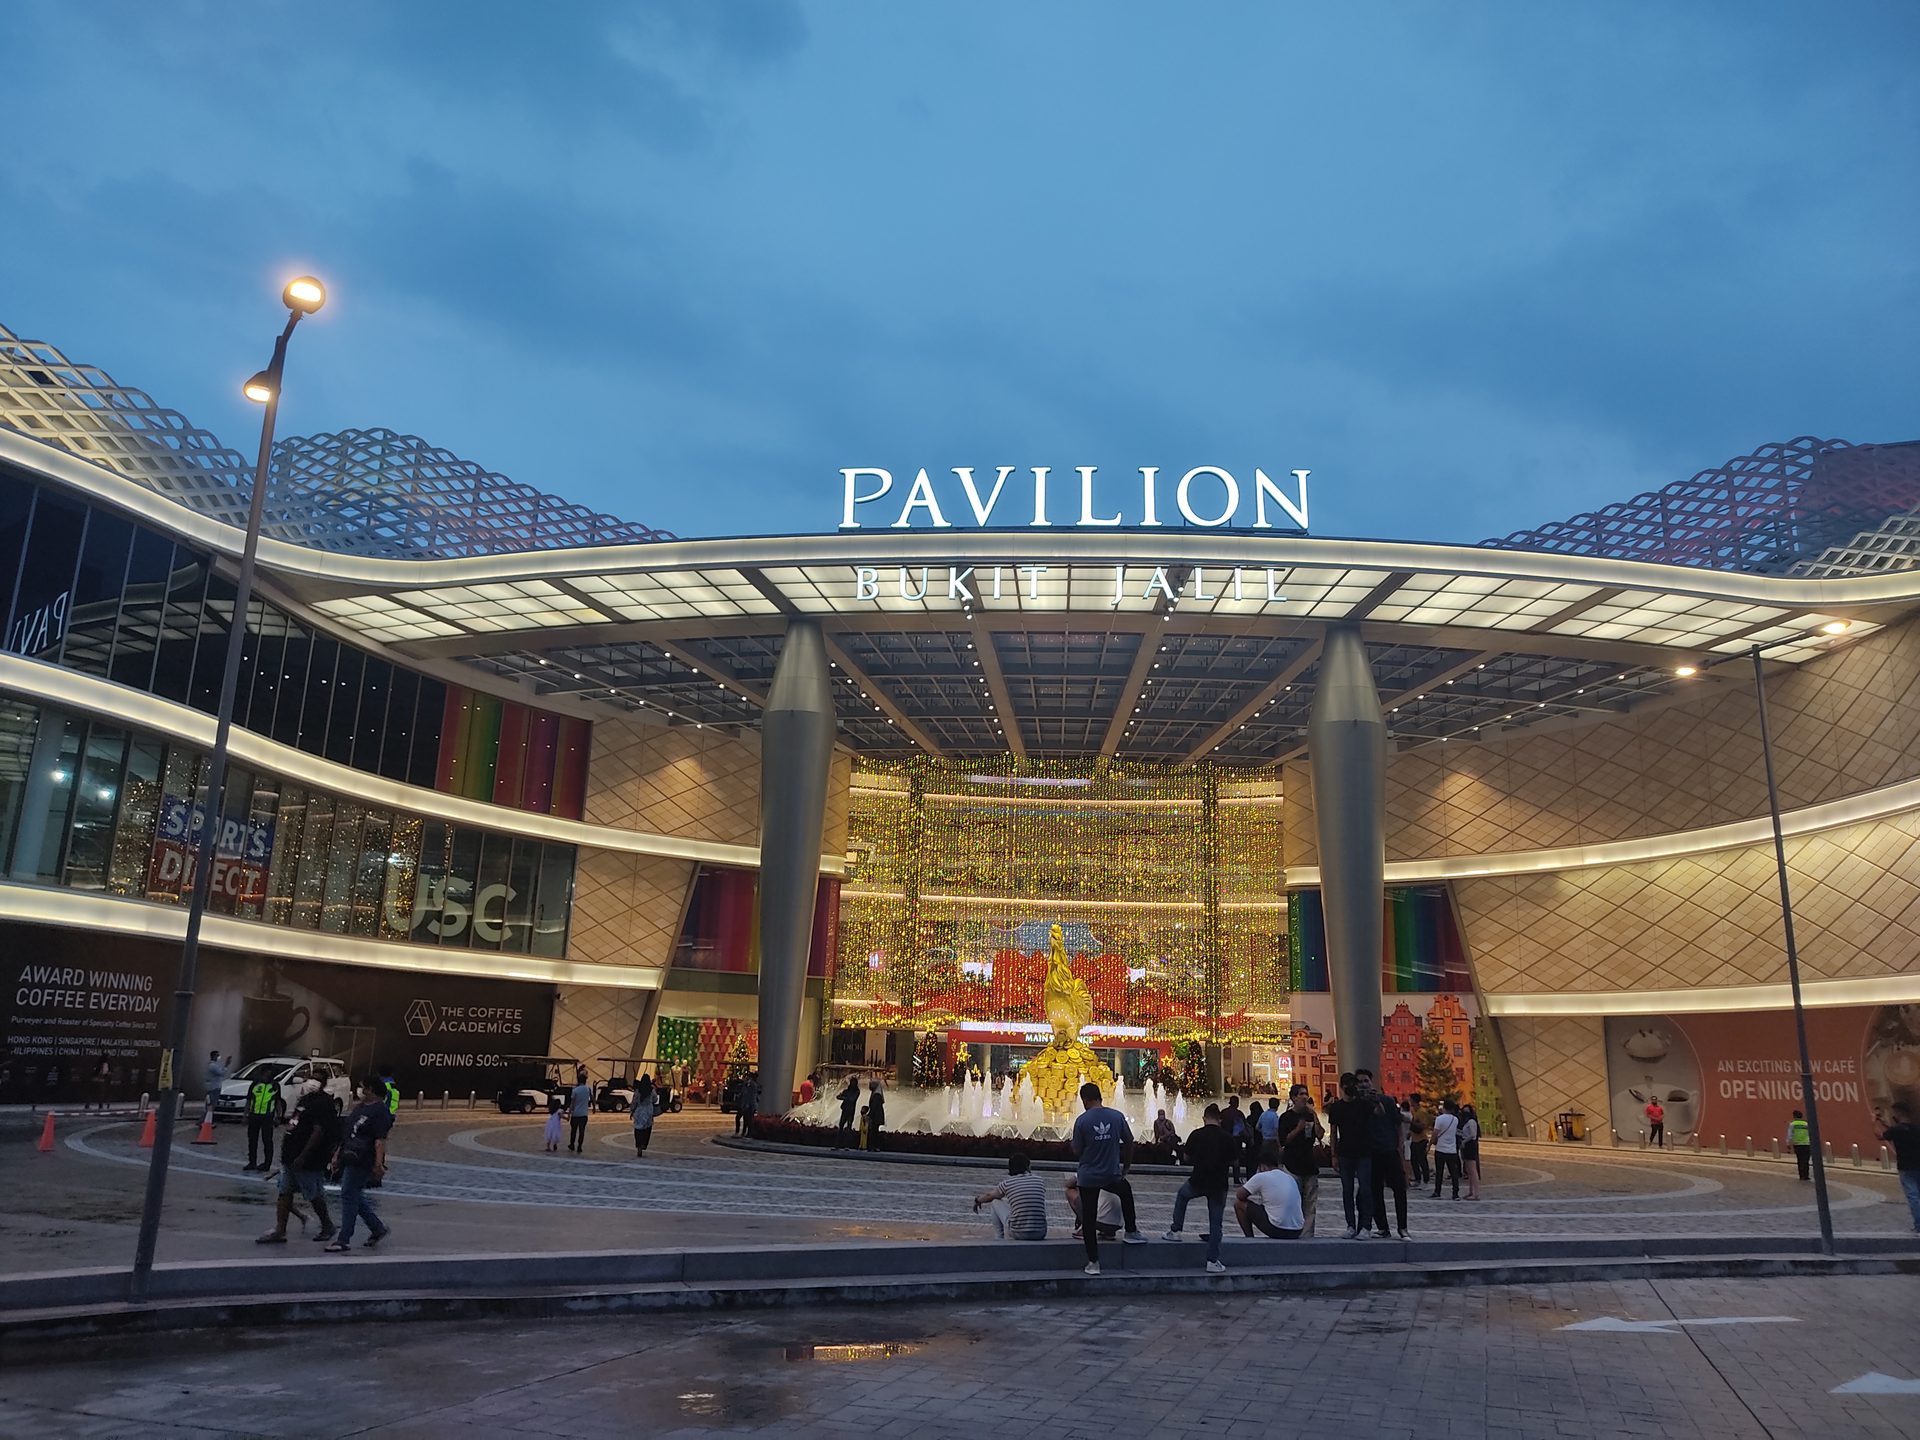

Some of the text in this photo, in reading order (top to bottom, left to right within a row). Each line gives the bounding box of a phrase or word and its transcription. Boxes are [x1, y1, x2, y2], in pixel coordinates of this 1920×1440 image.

[838, 466, 1312, 529] PAVILION
[856, 565, 1287, 605] BUKIT JALIL
[166, 804, 268, 857] SPRTS
[158, 850, 261, 896] DIECT
[384, 862, 518, 943] USC
[19, 964, 153, 992] AWARD WINNING
[16, 987, 160, 1013] COFFEE EVERYDAY
[441, 1006, 523, 1020] THE COFFEE
[8, 1035, 31, 1045] HONG
[32, 1036, 53, 1045] KONG
[58, 1037, 96, 1046] SINGAPORE
[101, 1038, 129, 1047] MALAYSIA
[1025, 1033, 1049, 1043] MAIN
[10, 1047, 54, 1056] HILIPPINES
[58, 1048, 80, 1056] CHINA
[419, 1053, 473, 1067] OPENING
[1718, 1060, 1734, 1073] AN
[1737, 1060, 1792, 1073] EXCITING
[1795, 1060, 1821, 1073] NW
[1720, 1079, 1804, 1101] OPENING
